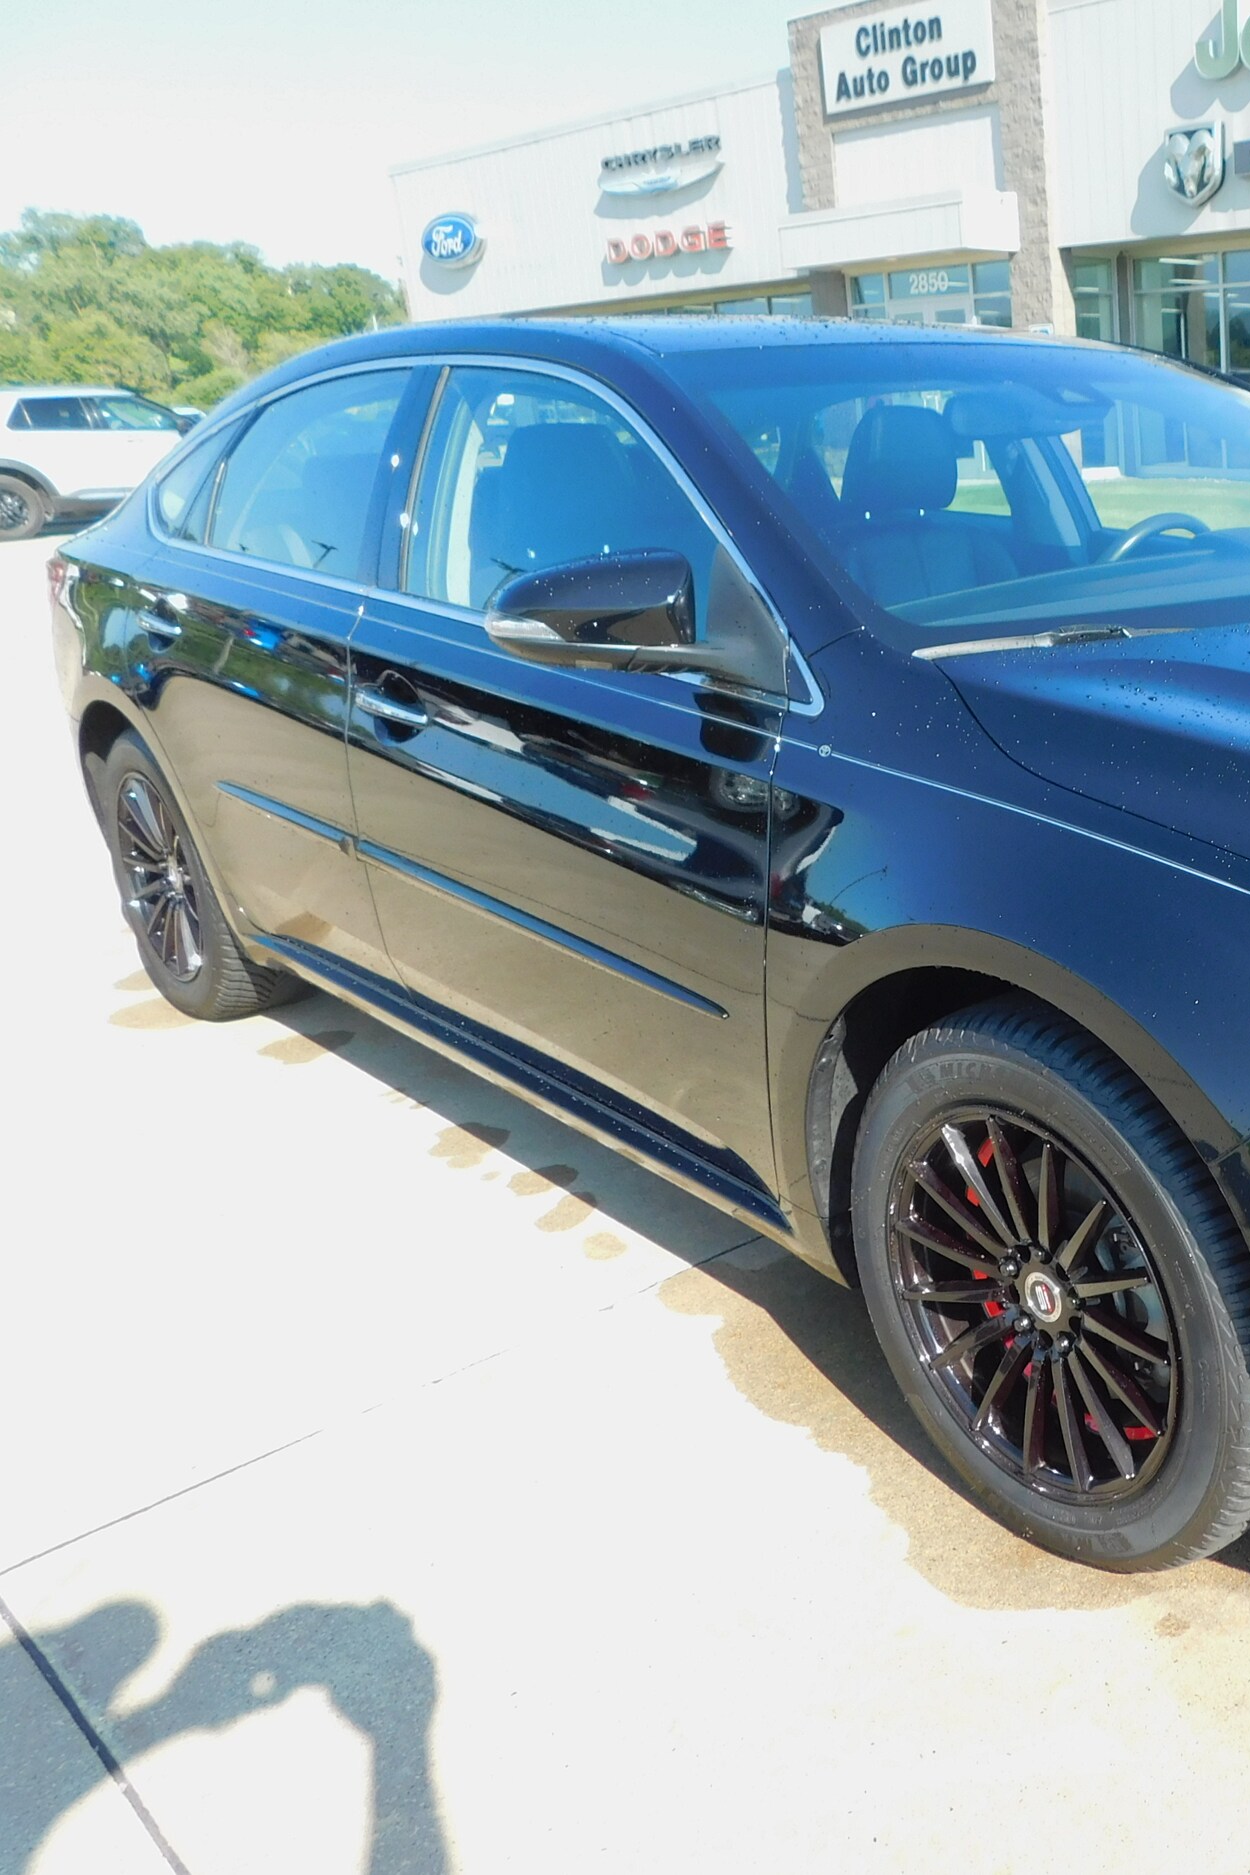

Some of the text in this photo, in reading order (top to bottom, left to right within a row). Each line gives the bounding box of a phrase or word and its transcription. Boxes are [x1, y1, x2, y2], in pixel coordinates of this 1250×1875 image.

[855, 15, 942, 58] Clinton
[836, 49, 977, 102] Auto Group
[601, 134, 722, 171] CHRYSLER
[431, 224, 464, 258] Ford
[606, 219, 729, 264] DODGE
[909, 270, 949, 295] 2850
